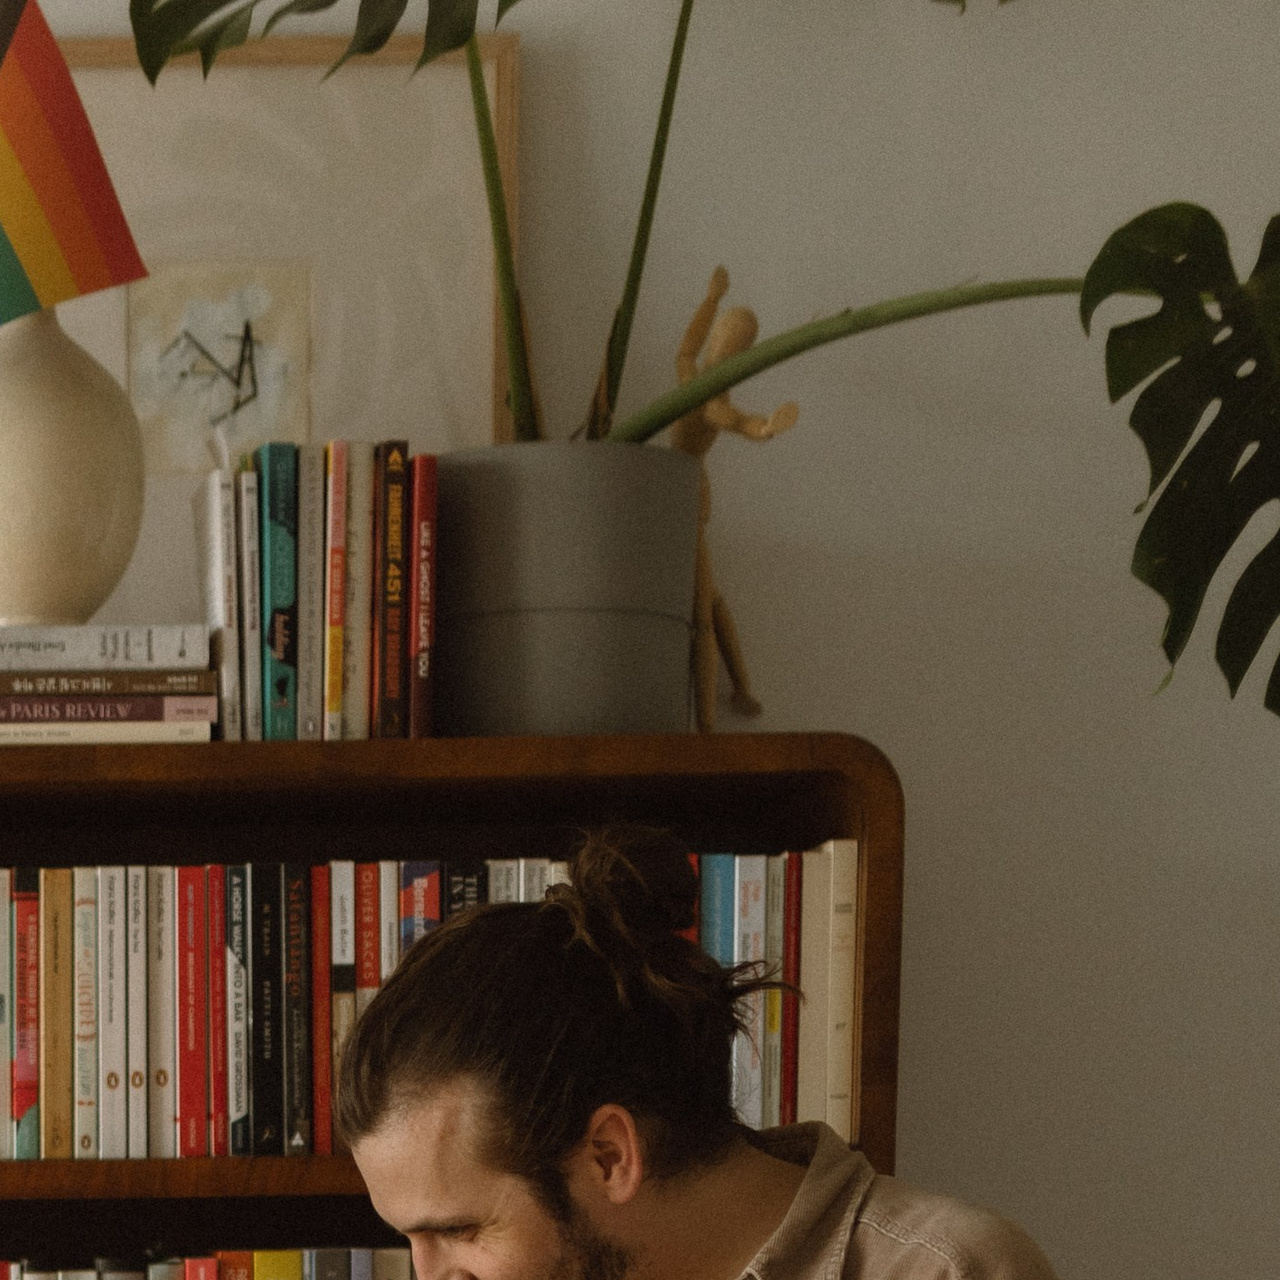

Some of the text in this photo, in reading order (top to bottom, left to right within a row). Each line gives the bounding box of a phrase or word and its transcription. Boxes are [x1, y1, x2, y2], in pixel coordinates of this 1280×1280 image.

[276, 461, 289, 604] GRAHAM NORTON
[387, 483, 402, 602] FAHRENHEIT 451
[420, 521, 430, 548] LIKE
[420, 549, 430, 559] A
[419, 562, 429, 602] GHOST
[272, 614, 289, 660] holding
[418, 611, 429, 649] LEAVE
[418, 652, 429, 678] YOU
[11, 703, 61, 719] PARIS
[65, 702, 132, 718] REVIEW
[231, 875, 244, 1022] A HORSE WALKS INTO A BAR
[262, 919, 271, 956] TRAIN
[339, 894, 349, 958] Judith Butler
[361, 870, 374, 981] OLIVER SACKS
[262, 980, 272, 1060] PATTI SMITH
[234, 1031, 244, 1113] DAVID GROSSMAN
